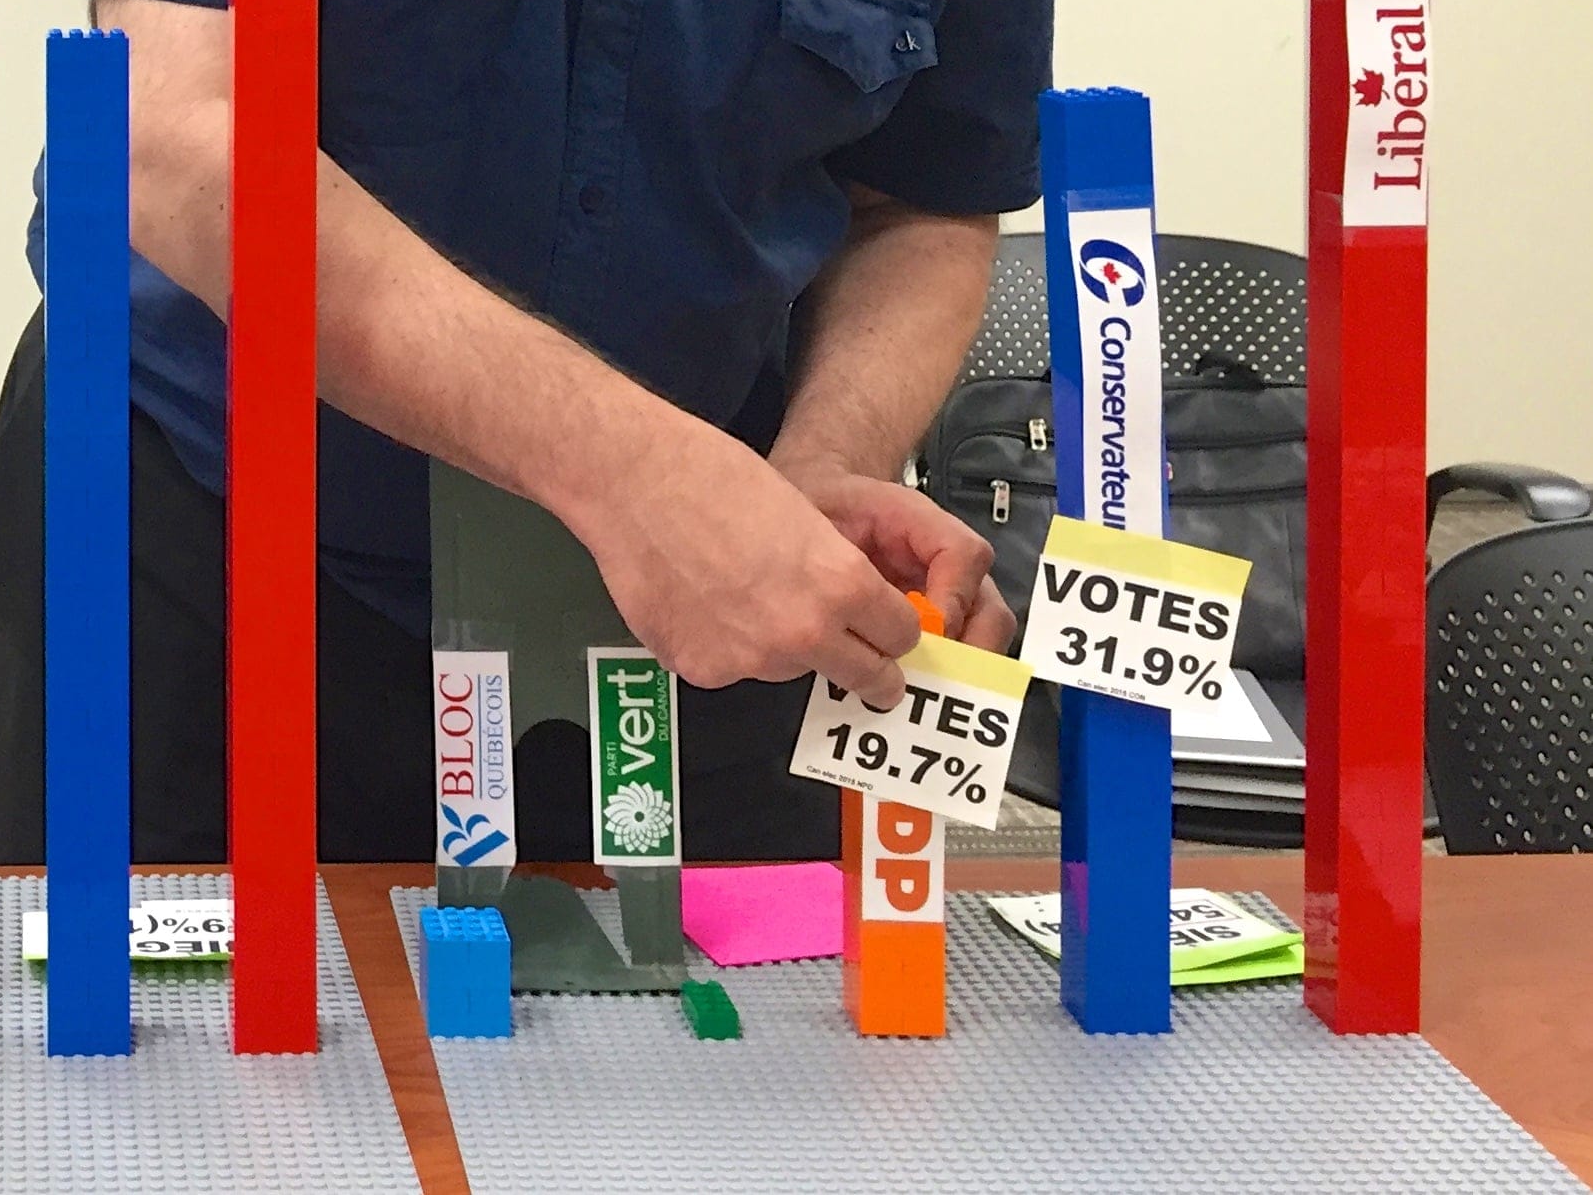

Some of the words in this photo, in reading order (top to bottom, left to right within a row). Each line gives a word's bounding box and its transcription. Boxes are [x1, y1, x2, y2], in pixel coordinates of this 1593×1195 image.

[1374, 4, 1428, 190] Liberal
[1042, 562, 1230, 641] VOTES
[656, 669, 669, 721] CANADA
[1055, 625, 1223, 702] 31.9%
[438, 673, 475, 798] BLOC
[481, 674, 507, 801] QUÉBÉCOIS
[606, 668, 656, 775] vert
[657, 723, 669, 742] DU
[827, 678, 1010, 749] TES
[607, 741, 617, 776] PARTI
[826, 723, 987, 804] 19.7%
[875, 801, 933, 912] DP
